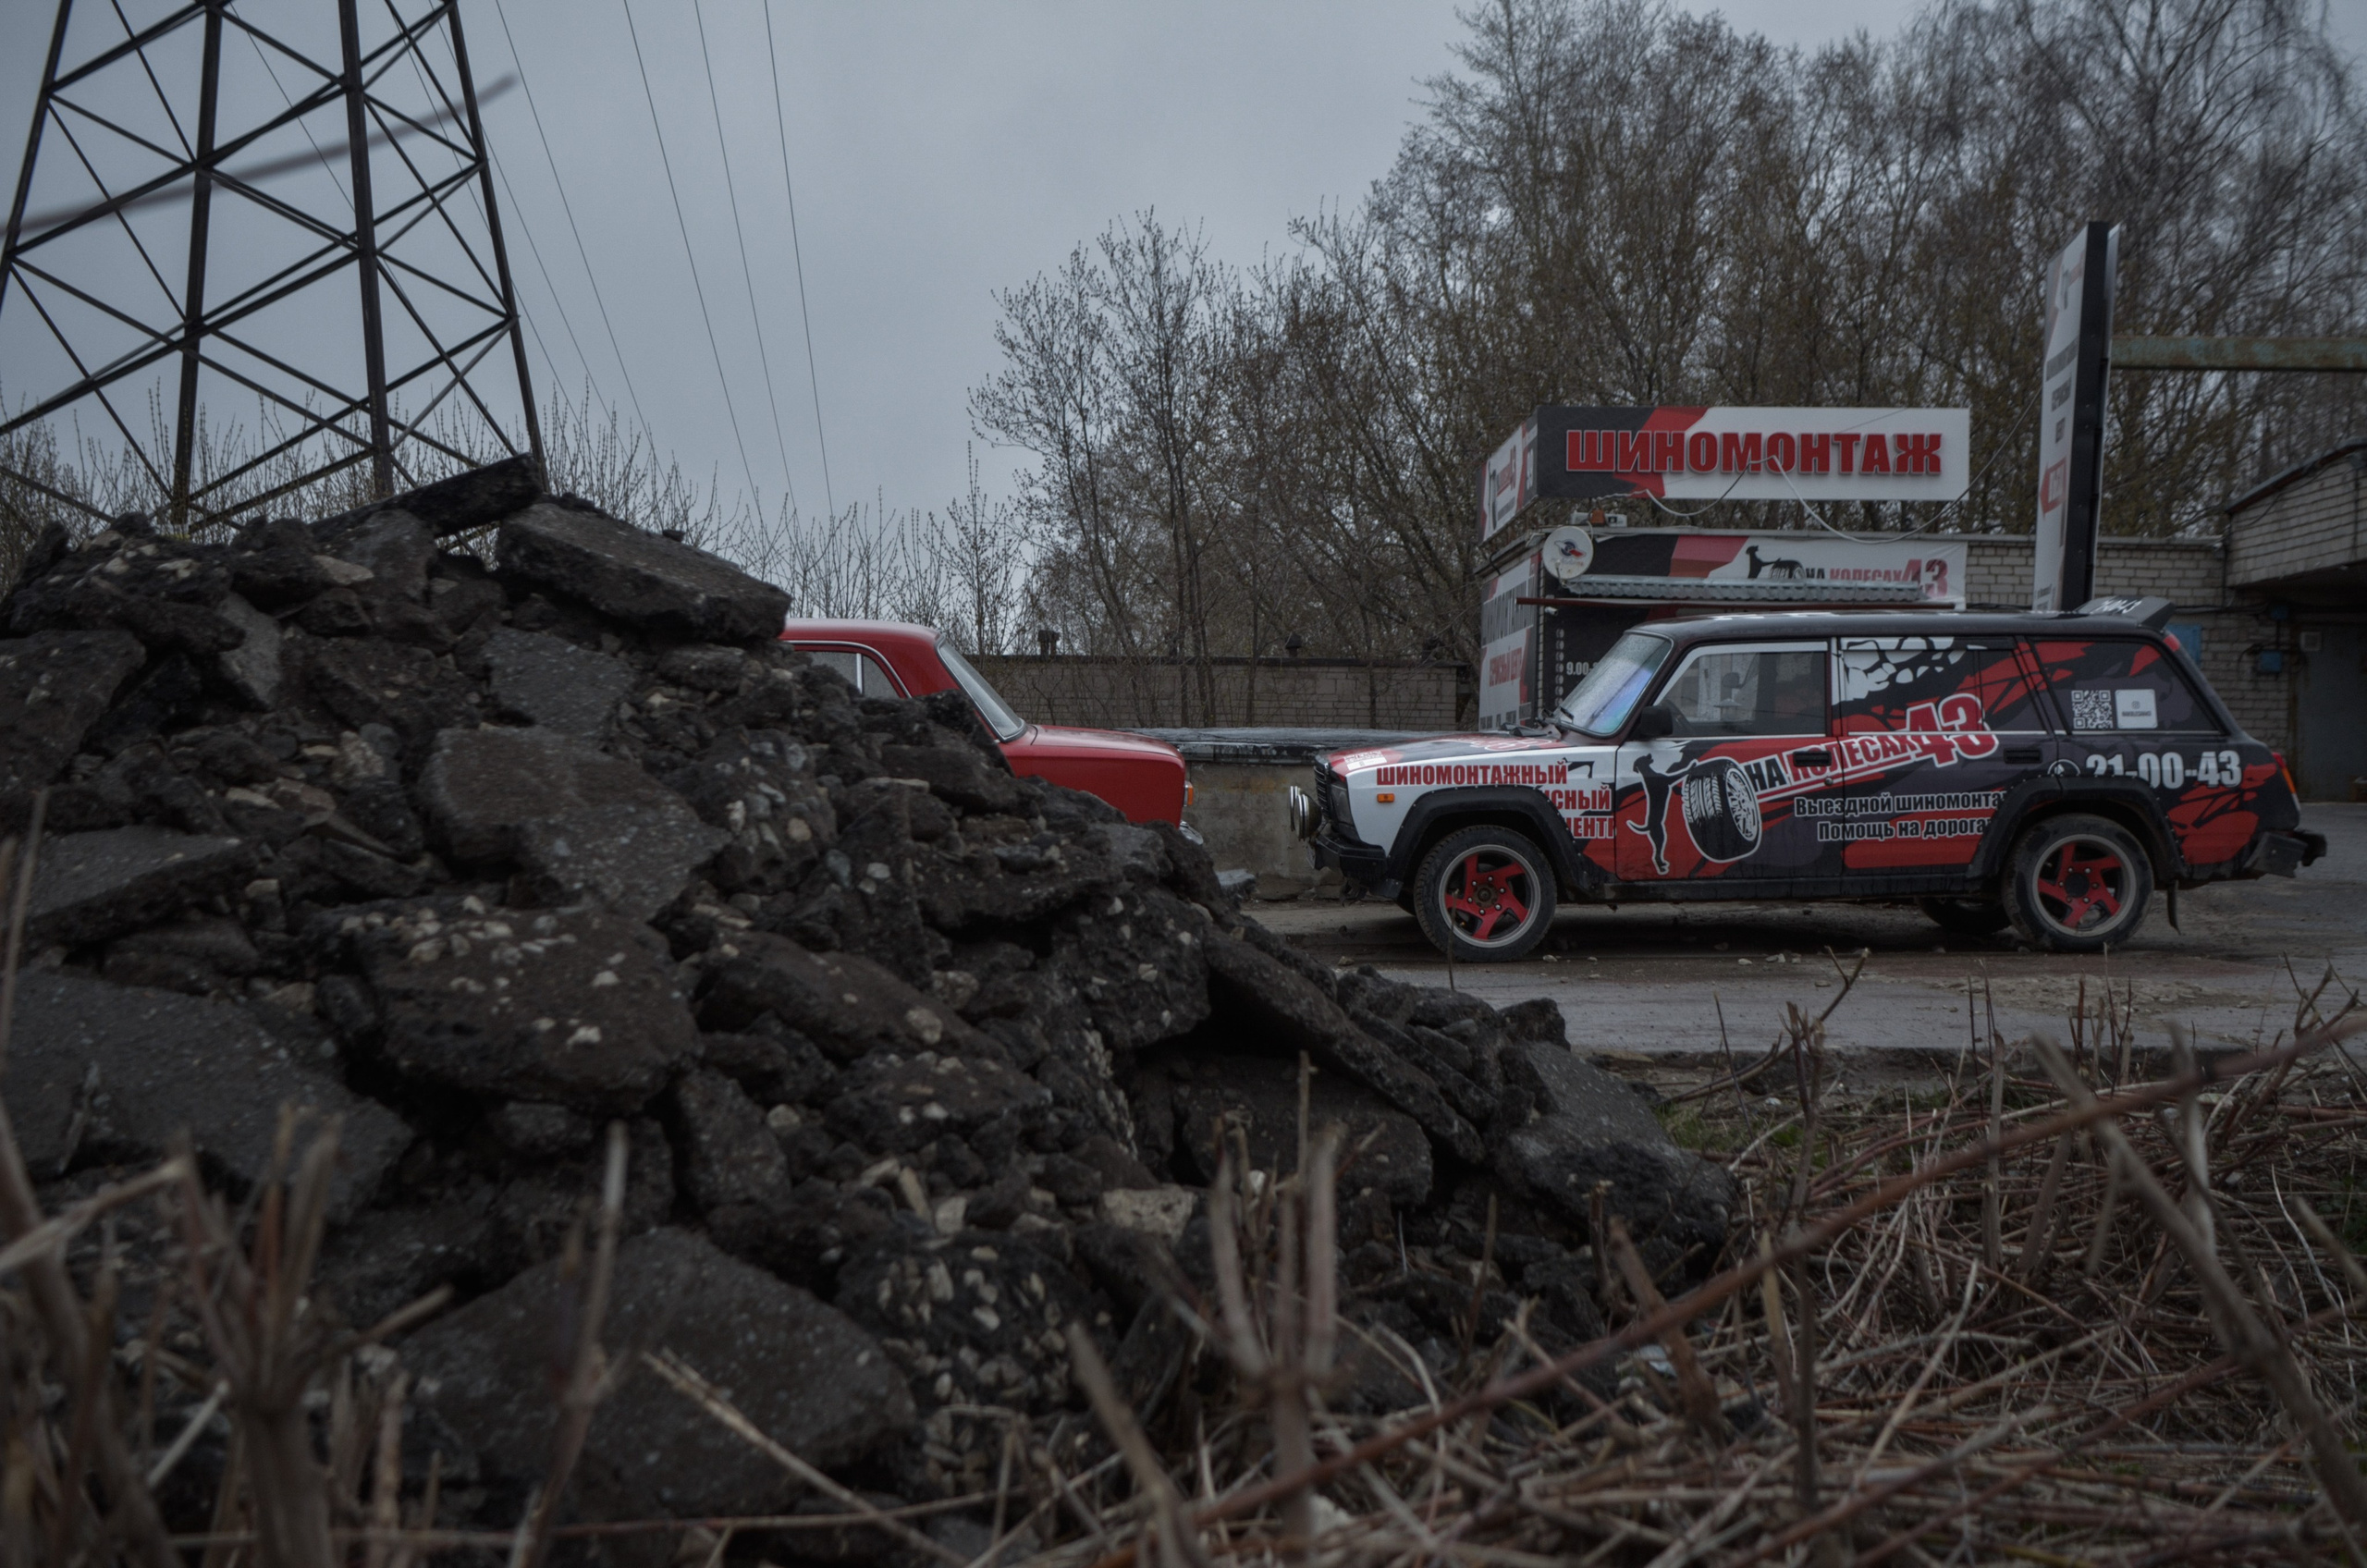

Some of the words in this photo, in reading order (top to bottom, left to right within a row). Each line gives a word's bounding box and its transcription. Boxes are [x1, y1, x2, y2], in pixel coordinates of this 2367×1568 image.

[1566, 429, 1943, 475] ШИНОМОНТАЖ
[1565, 661, 1598, 677] 9.00-
[1745, 757, 1787, 792] НА
[1907, 693, 1998, 767] 43
[1376, 757, 1568, 786] ШИНОМОНТАЖНЫЙ
[2085, 749, 2242, 789] 21-00-43
[1543, 785, 1612, 811] СНЫЙ
[1796, 792, 1893, 816] Выездной
[1895, 791, 2006, 813] шиномонта
[1818, 820, 1894, 840] Помощь
[1896, 820, 1920, 837] на
[1923, 817, 1992, 838] дорога
